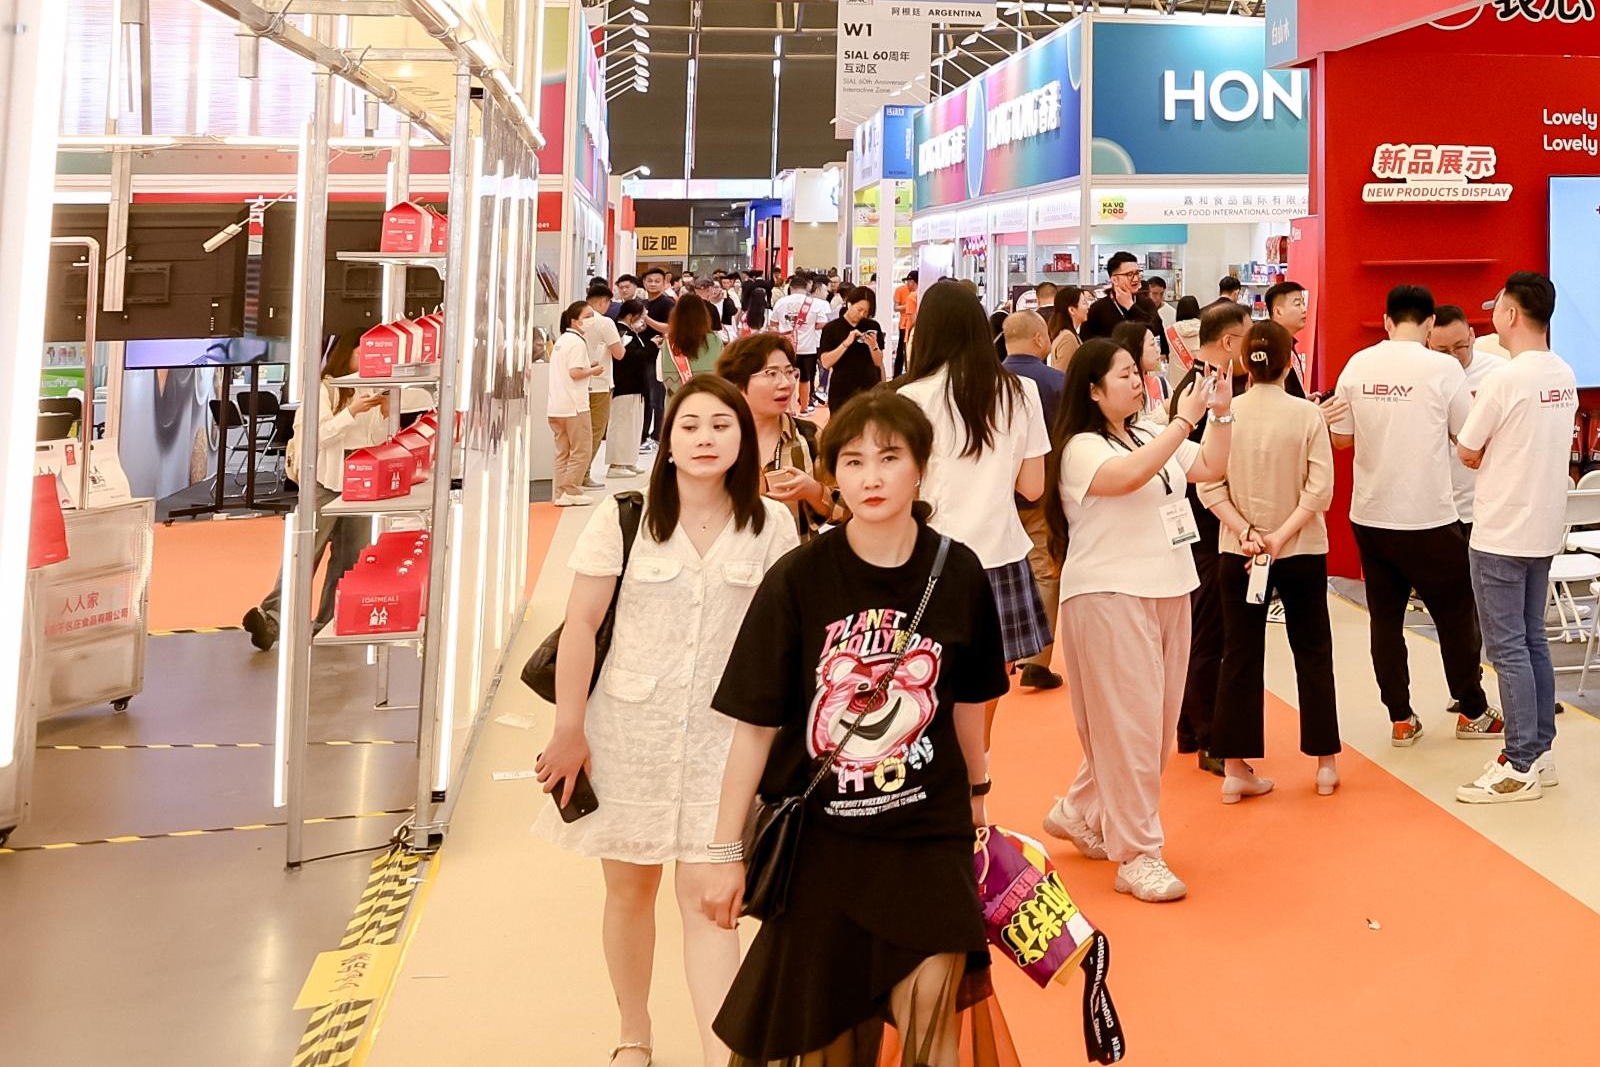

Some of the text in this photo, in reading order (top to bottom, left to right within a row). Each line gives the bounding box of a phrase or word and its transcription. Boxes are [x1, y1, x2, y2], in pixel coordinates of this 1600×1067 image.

[928, 9, 982, 18] ARGENTINA
[844, 23, 872, 37] W1
[844, 51, 869, 60] SIAL
[844, 64, 877, 74] 互动区
[1163, 69, 1309, 122] HON
[1543, 108, 1598, 130] Lovely
[1543, 134, 1598, 156] Lovely
[1377, 148, 1492, 175] 新品展示
[1367, 187, 1508, 197] NEW PRODUCTS DISPLAY
[637, 235, 677, 250] 吃吧
[60, 591, 99, 615] 人人家
[819, 608, 907, 660] PLANET
